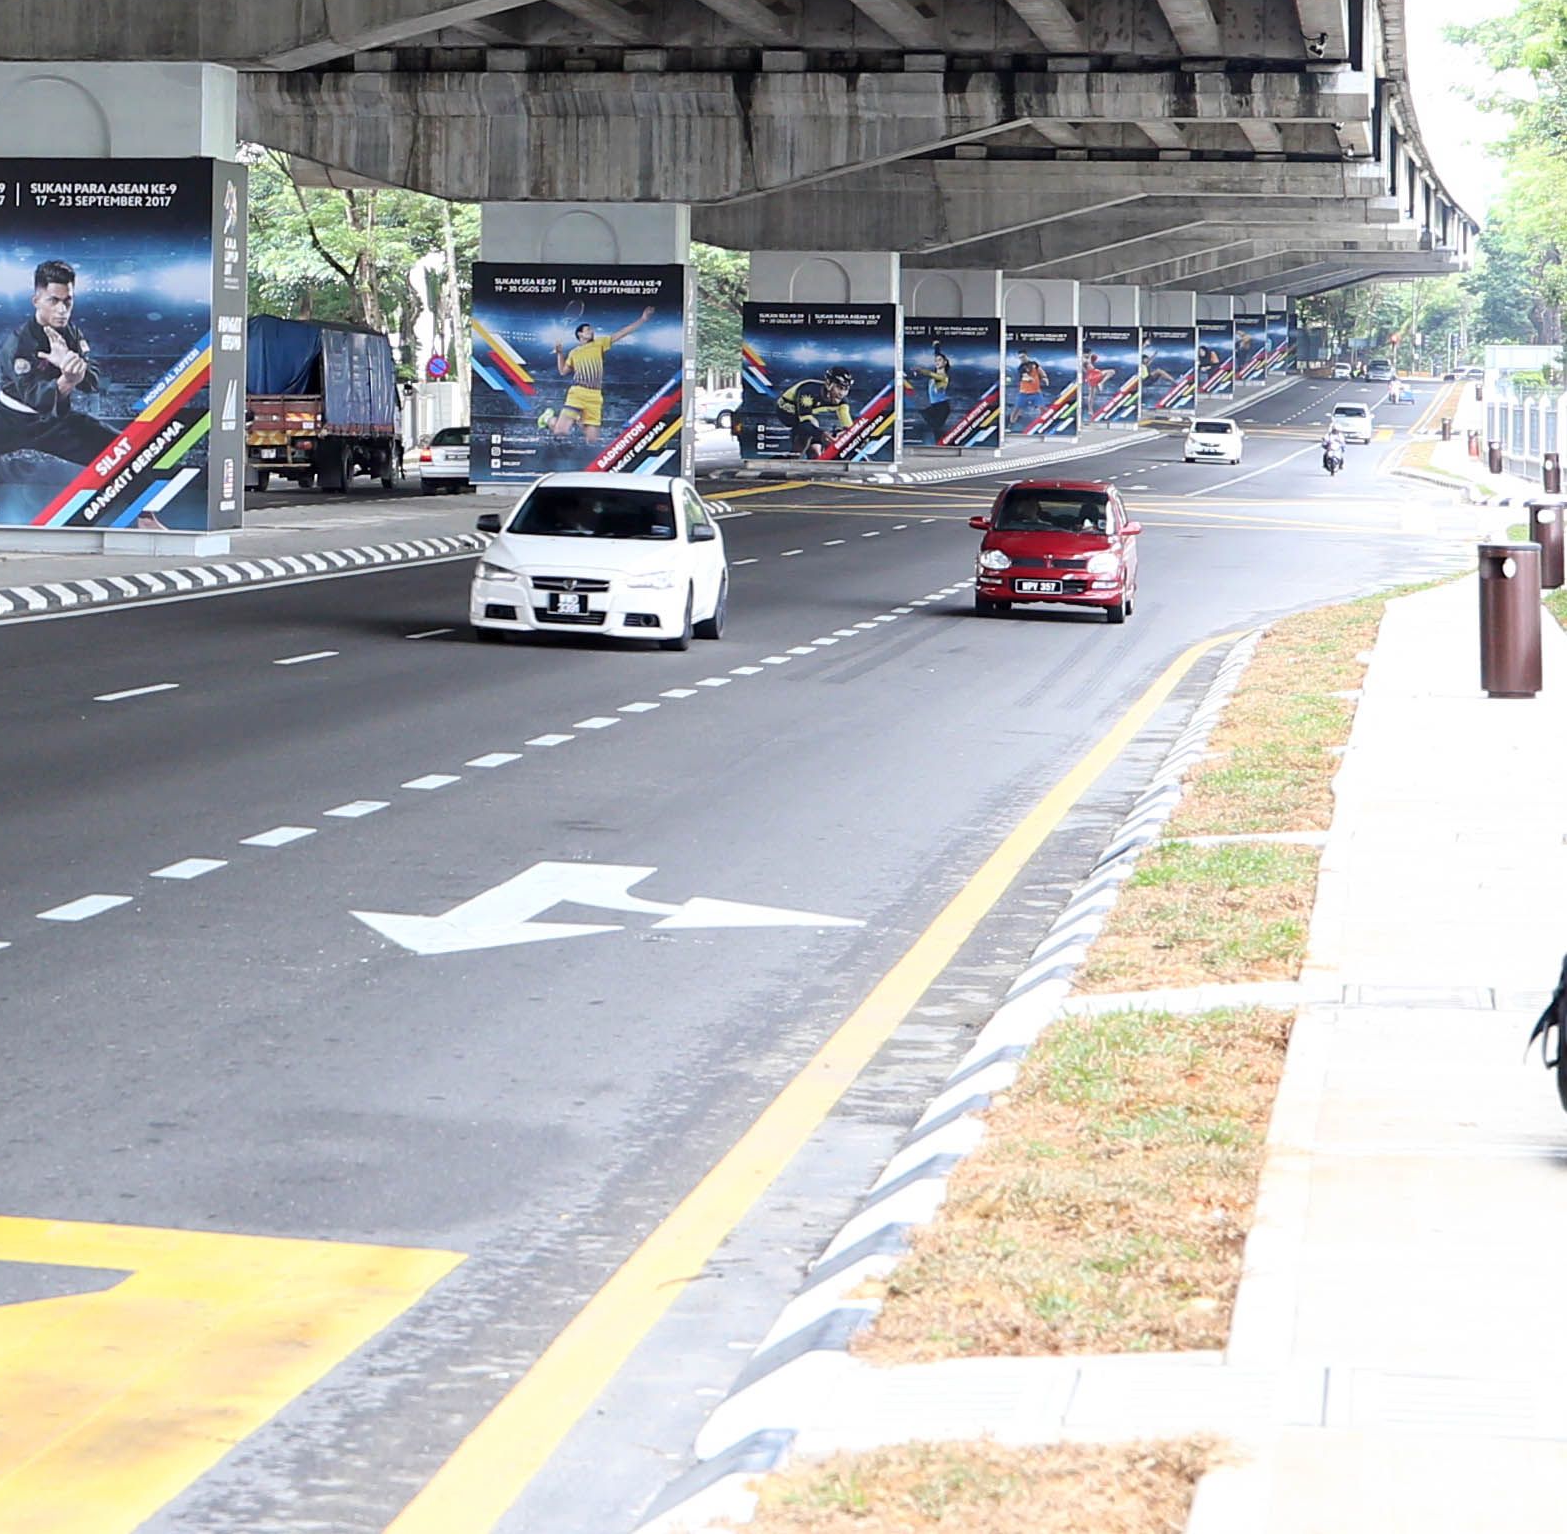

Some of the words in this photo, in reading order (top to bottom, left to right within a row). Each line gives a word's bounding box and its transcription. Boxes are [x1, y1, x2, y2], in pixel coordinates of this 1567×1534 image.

[30, 183, 72, 194] SUKAN
[74, 183, 106, 194] PARA
[108, 183, 149, 195] ASEAN
[151, 184, 177, 195] KE-9
[35, 196, 47, 207] 17
[58, 196, 72, 207] 23
[74, 196, 143, 207] SEPTEMBER
[145, 196, 171, 207] 2017
[95, 437, 132, 477] SILAT
[597, 422, 646, 468] BADMINTON
[84, 468, 133, 520] BANGKIT
[131, 420, 185, 474] BERSAMA
